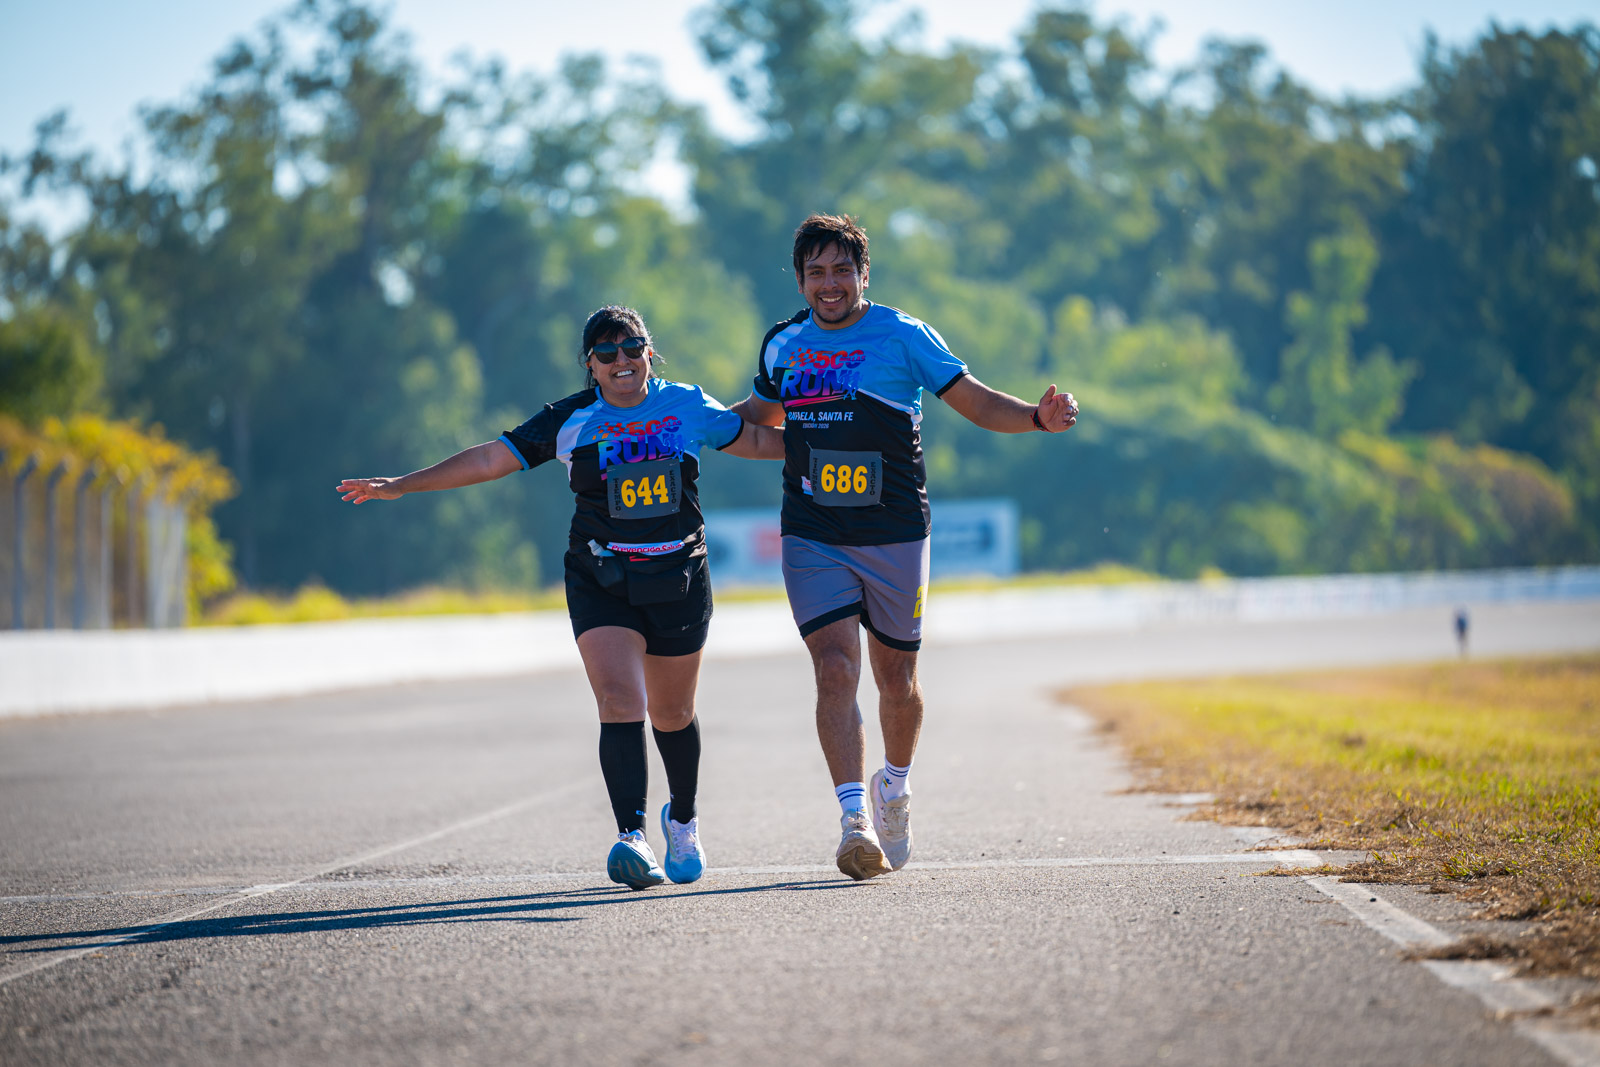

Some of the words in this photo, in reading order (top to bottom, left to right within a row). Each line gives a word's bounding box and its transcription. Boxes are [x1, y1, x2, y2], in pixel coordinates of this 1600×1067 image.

[781, 369, 861, 398] RUN
[818, 412, 842, 421] SANTA
[844, 412, 854, 421] FE
[598, 434, 683, 470] RUN
[621, 475, 669, 508] 644
[821, 464, 868, 494] 686
